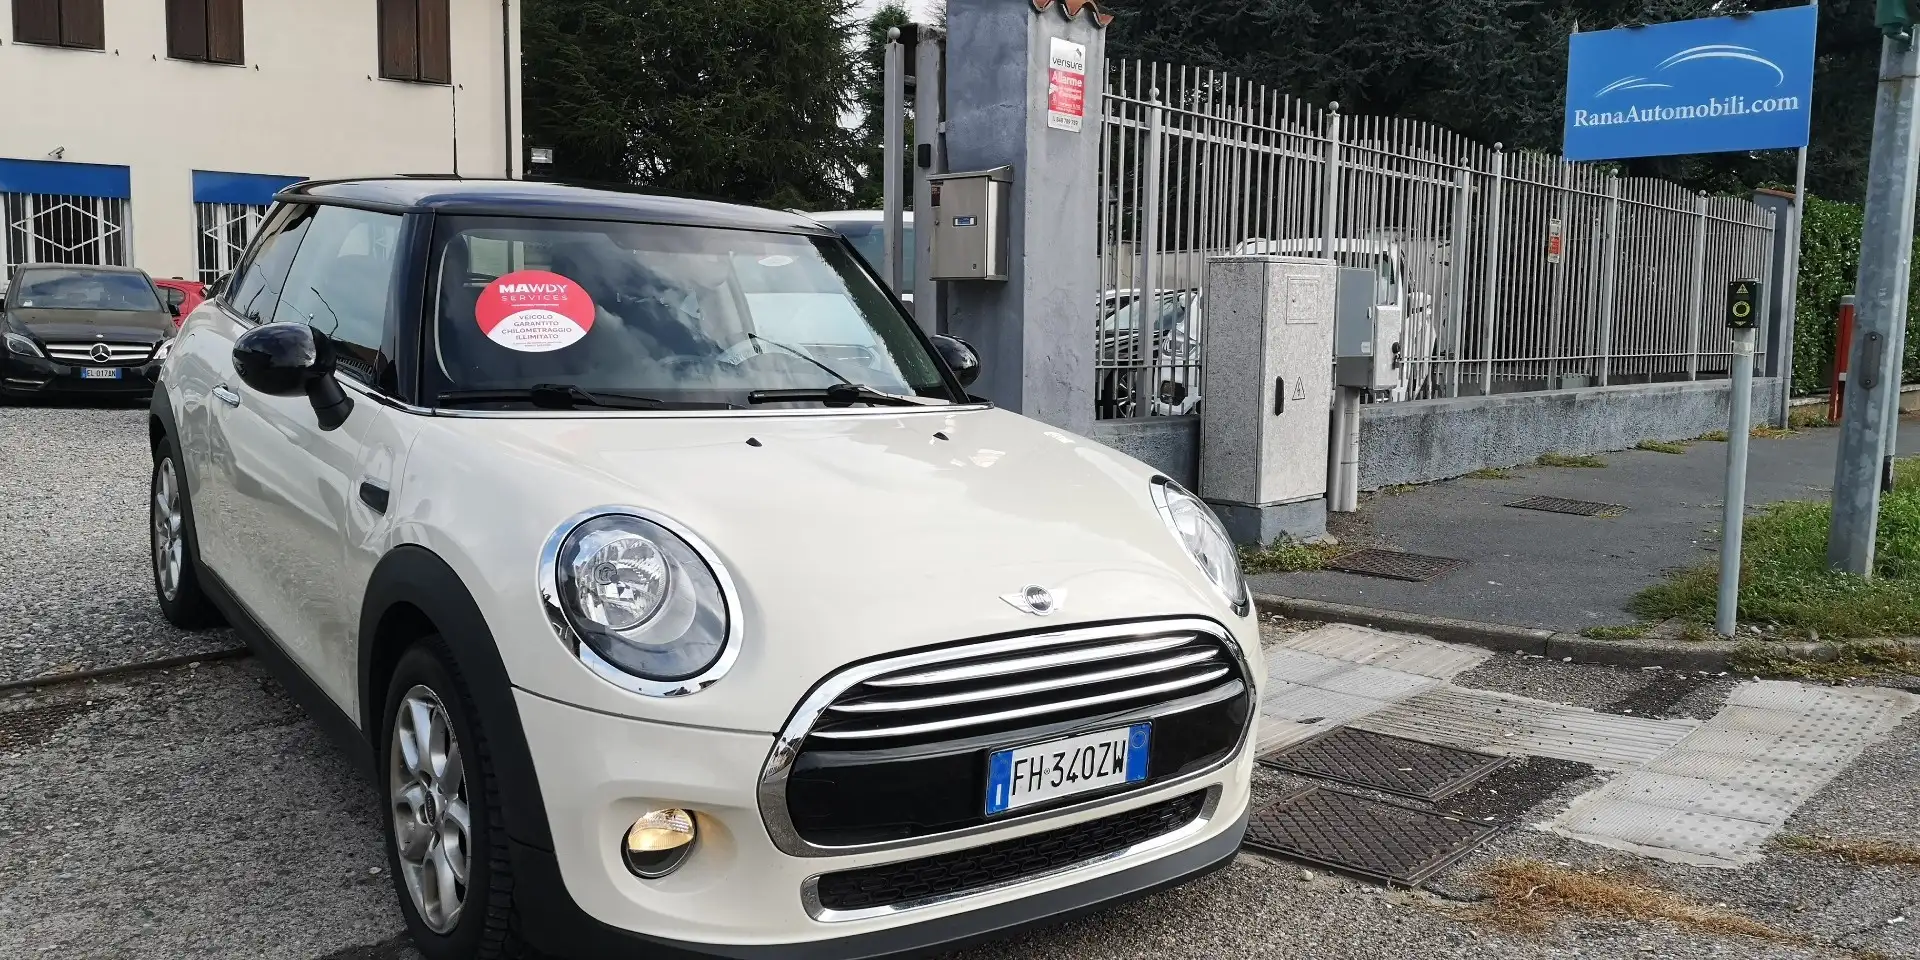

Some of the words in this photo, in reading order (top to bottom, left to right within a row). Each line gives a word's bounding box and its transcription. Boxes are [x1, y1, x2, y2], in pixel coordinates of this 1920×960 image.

[1052, 57, 1083, 71] verisure
[1051, 70, 1083, 87] Allarme
[1573, 95, 1799, 128] RanaAutomobili.com
[499, 283, 568, 294] MAWDY
[501, 327, 572, 335] CHILOMETRAGGIO
[1012, 755, 1044, 797] FH
[1051, 740, 1127, 788] 340ZW
